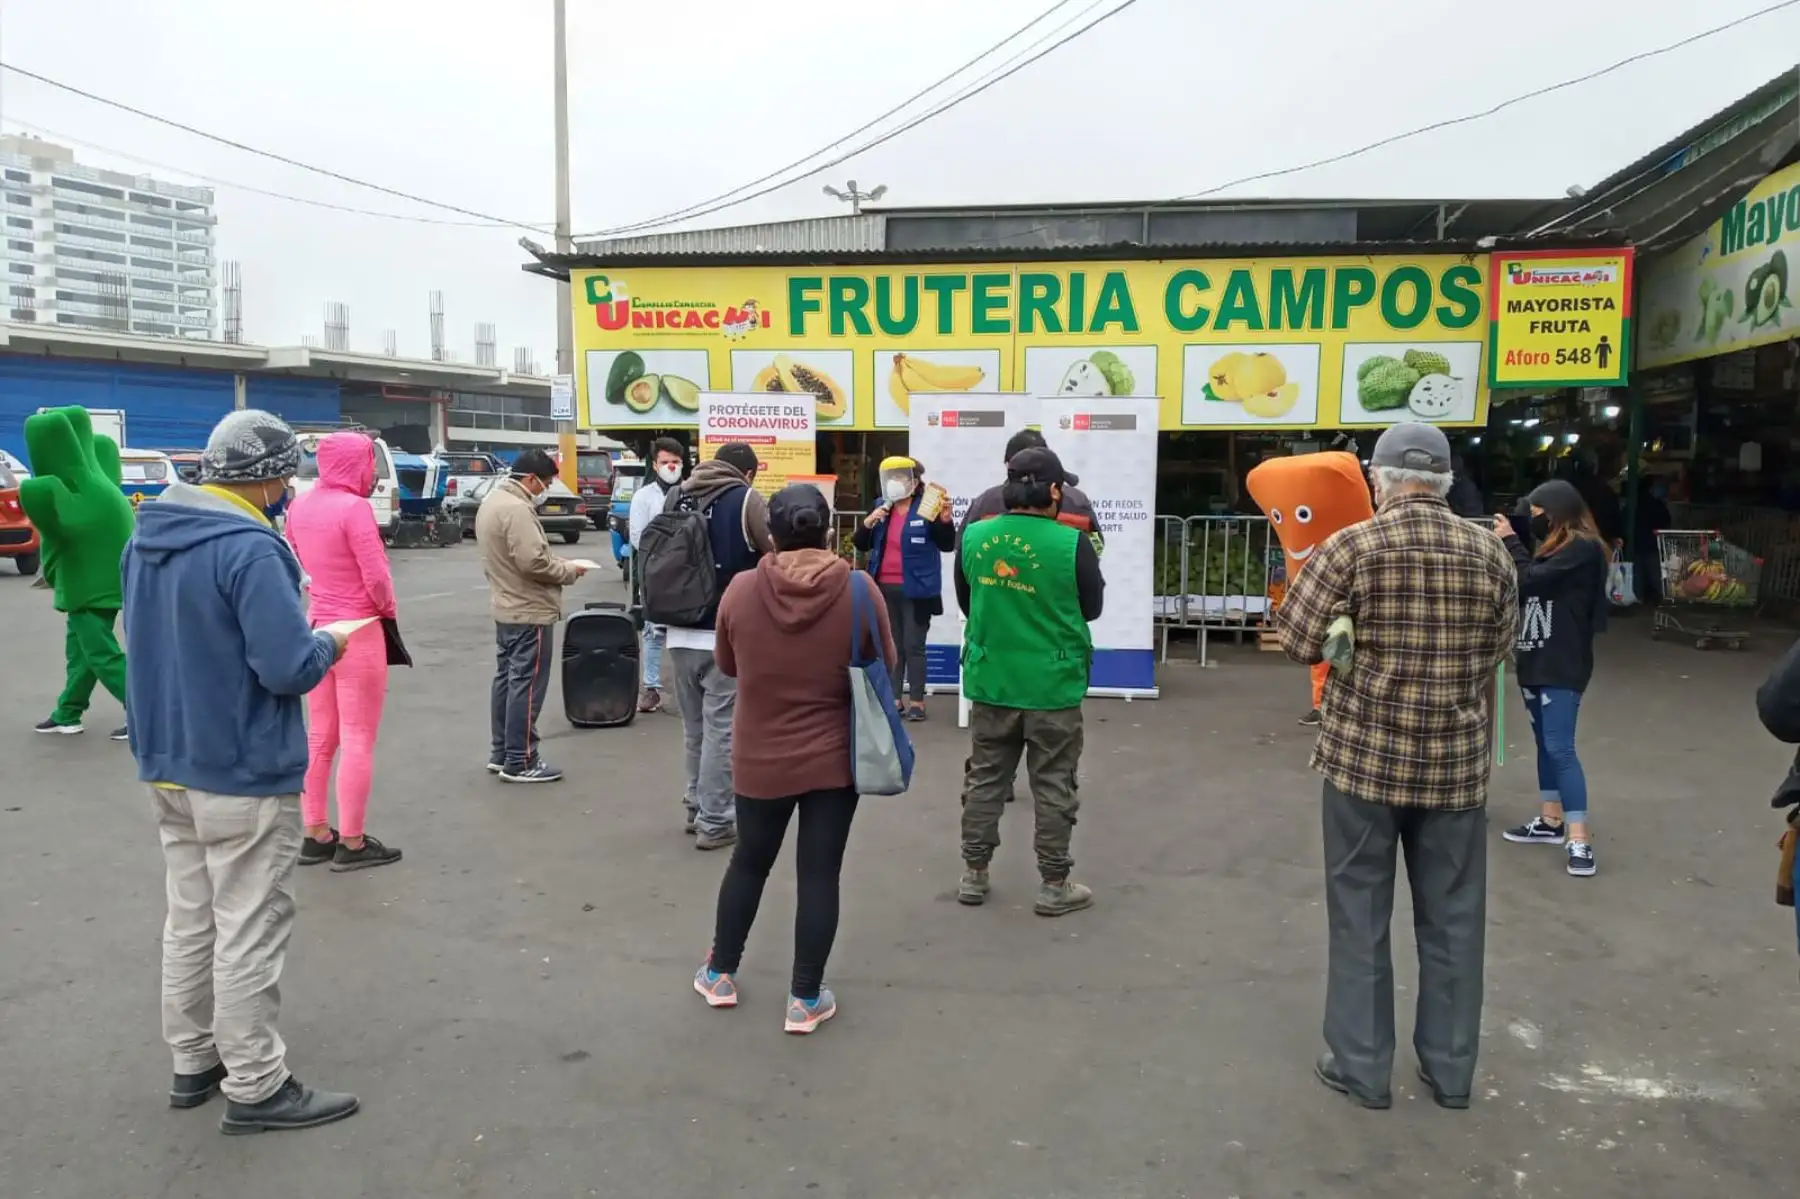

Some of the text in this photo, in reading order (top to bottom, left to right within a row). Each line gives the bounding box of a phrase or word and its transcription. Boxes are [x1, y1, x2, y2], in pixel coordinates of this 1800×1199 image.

[787, 266, 1483, 336] FRUTERIA CAMPOS
[1507, 298, 1615, 313] MAYORISTA
[1529, 319, 1591, 334] FRUTA
[1505, 347, 1591, 366] Aforo 548
[709, 402, 807, 416] PROTÉGETE DEL
[708, 417, 809, 429] CORONAVIRUS
[1105, 512, 1116, 520] DE
[1119, 512, 1148, 520] SALUD
[1100, 524, 1124, 532] ORTE
